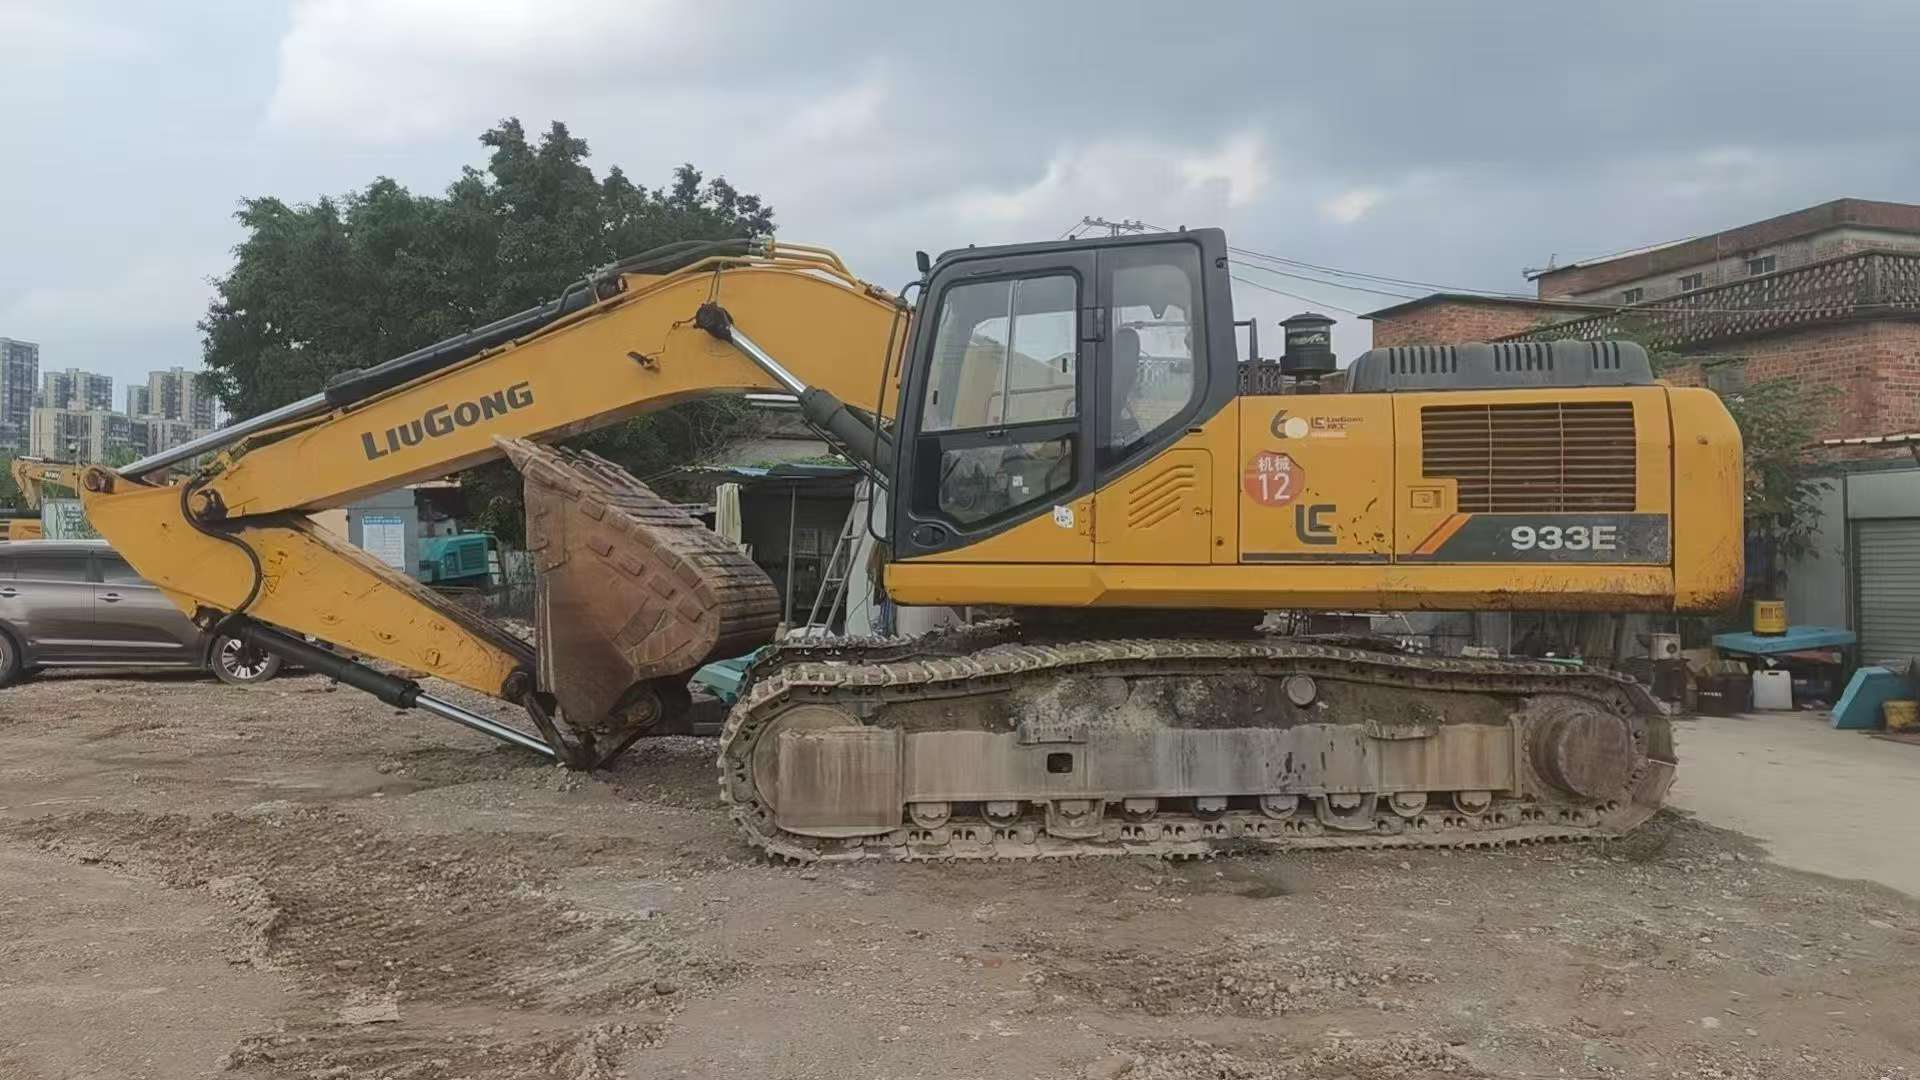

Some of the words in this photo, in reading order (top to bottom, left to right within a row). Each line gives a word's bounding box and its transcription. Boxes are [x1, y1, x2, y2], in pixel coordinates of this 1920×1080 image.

[361, 381, 534, 461] LIUGONG
[1258, 456, 1291, 472] 机械
[1258, 473, 1291, 500] 12
[1511, 525, 1617, 550] 933E
